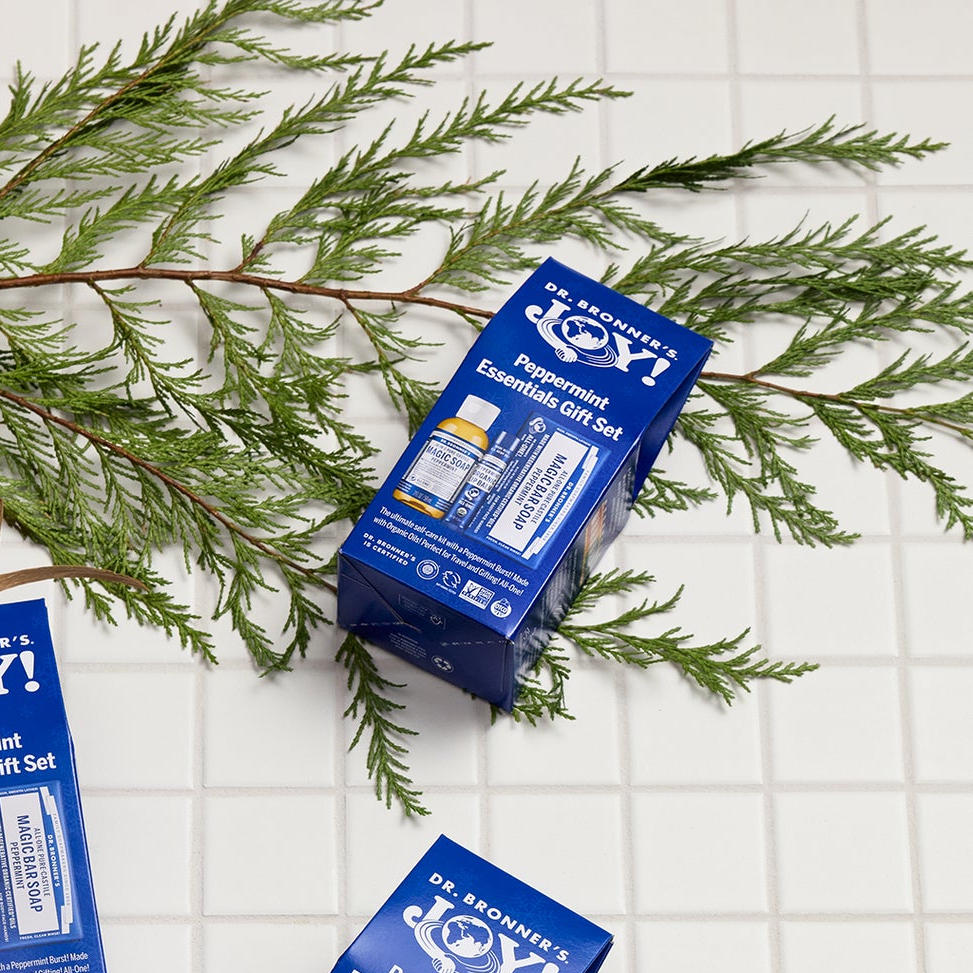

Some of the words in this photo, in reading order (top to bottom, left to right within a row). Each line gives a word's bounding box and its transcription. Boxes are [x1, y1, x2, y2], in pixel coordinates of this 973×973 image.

[544, 280, 572, 301] DR.
[524, 298, 670, 386] JOY!
[513, 353, 609, 410] Peppermint
[476, 358, 559, 408] Essentials
[559, 400, 593, 426] Gift
[592, 417, 623, 441] Set
[425, 444, 451, 461] MAGIC
[449, 456, 470, 473] SOAP
[540, 453, 567, 485] MAGIC
[527, 483, 547, 504] BAR
[512, 503, 534, 530] SOAP
[373, 516, 386, 526] with
[385, 521, 408, 537] Organic
[420, 538, 442, 554] Perfect
[441, 549, 451, 558] for
[450, 553, 468, 567] Travel
[466, 563, 480, 573] and
[478, 568, 501, 584] Gifting!
[498, 579, 523, 595] All-One!
[379, 505, 391, 516] The
[389, 512, 414, 528] ultimate
[413, 524, 438, 540] self-care
[437, 535, 447, 544] kit
[445, 540, 459, 550] with
[462, 547, 496, 569] Peppermint
[494, 564, 514, 577] Burst!
[512, 573, 528, 586] Made
[23, 752, 56, 772] Set
[16, 814, 34, 854] MAGIC
[22, 855, 37, 879] BAR
[26, 880, 42, 912] SOAP
[426, 870, 456, 896] DR.
[10, 956, 48, 970] Peppermint
[48, 953, 69, 964] Burst!
[69, 951, 88, 961] Made
[63, 963, 89, 973] All-One!
